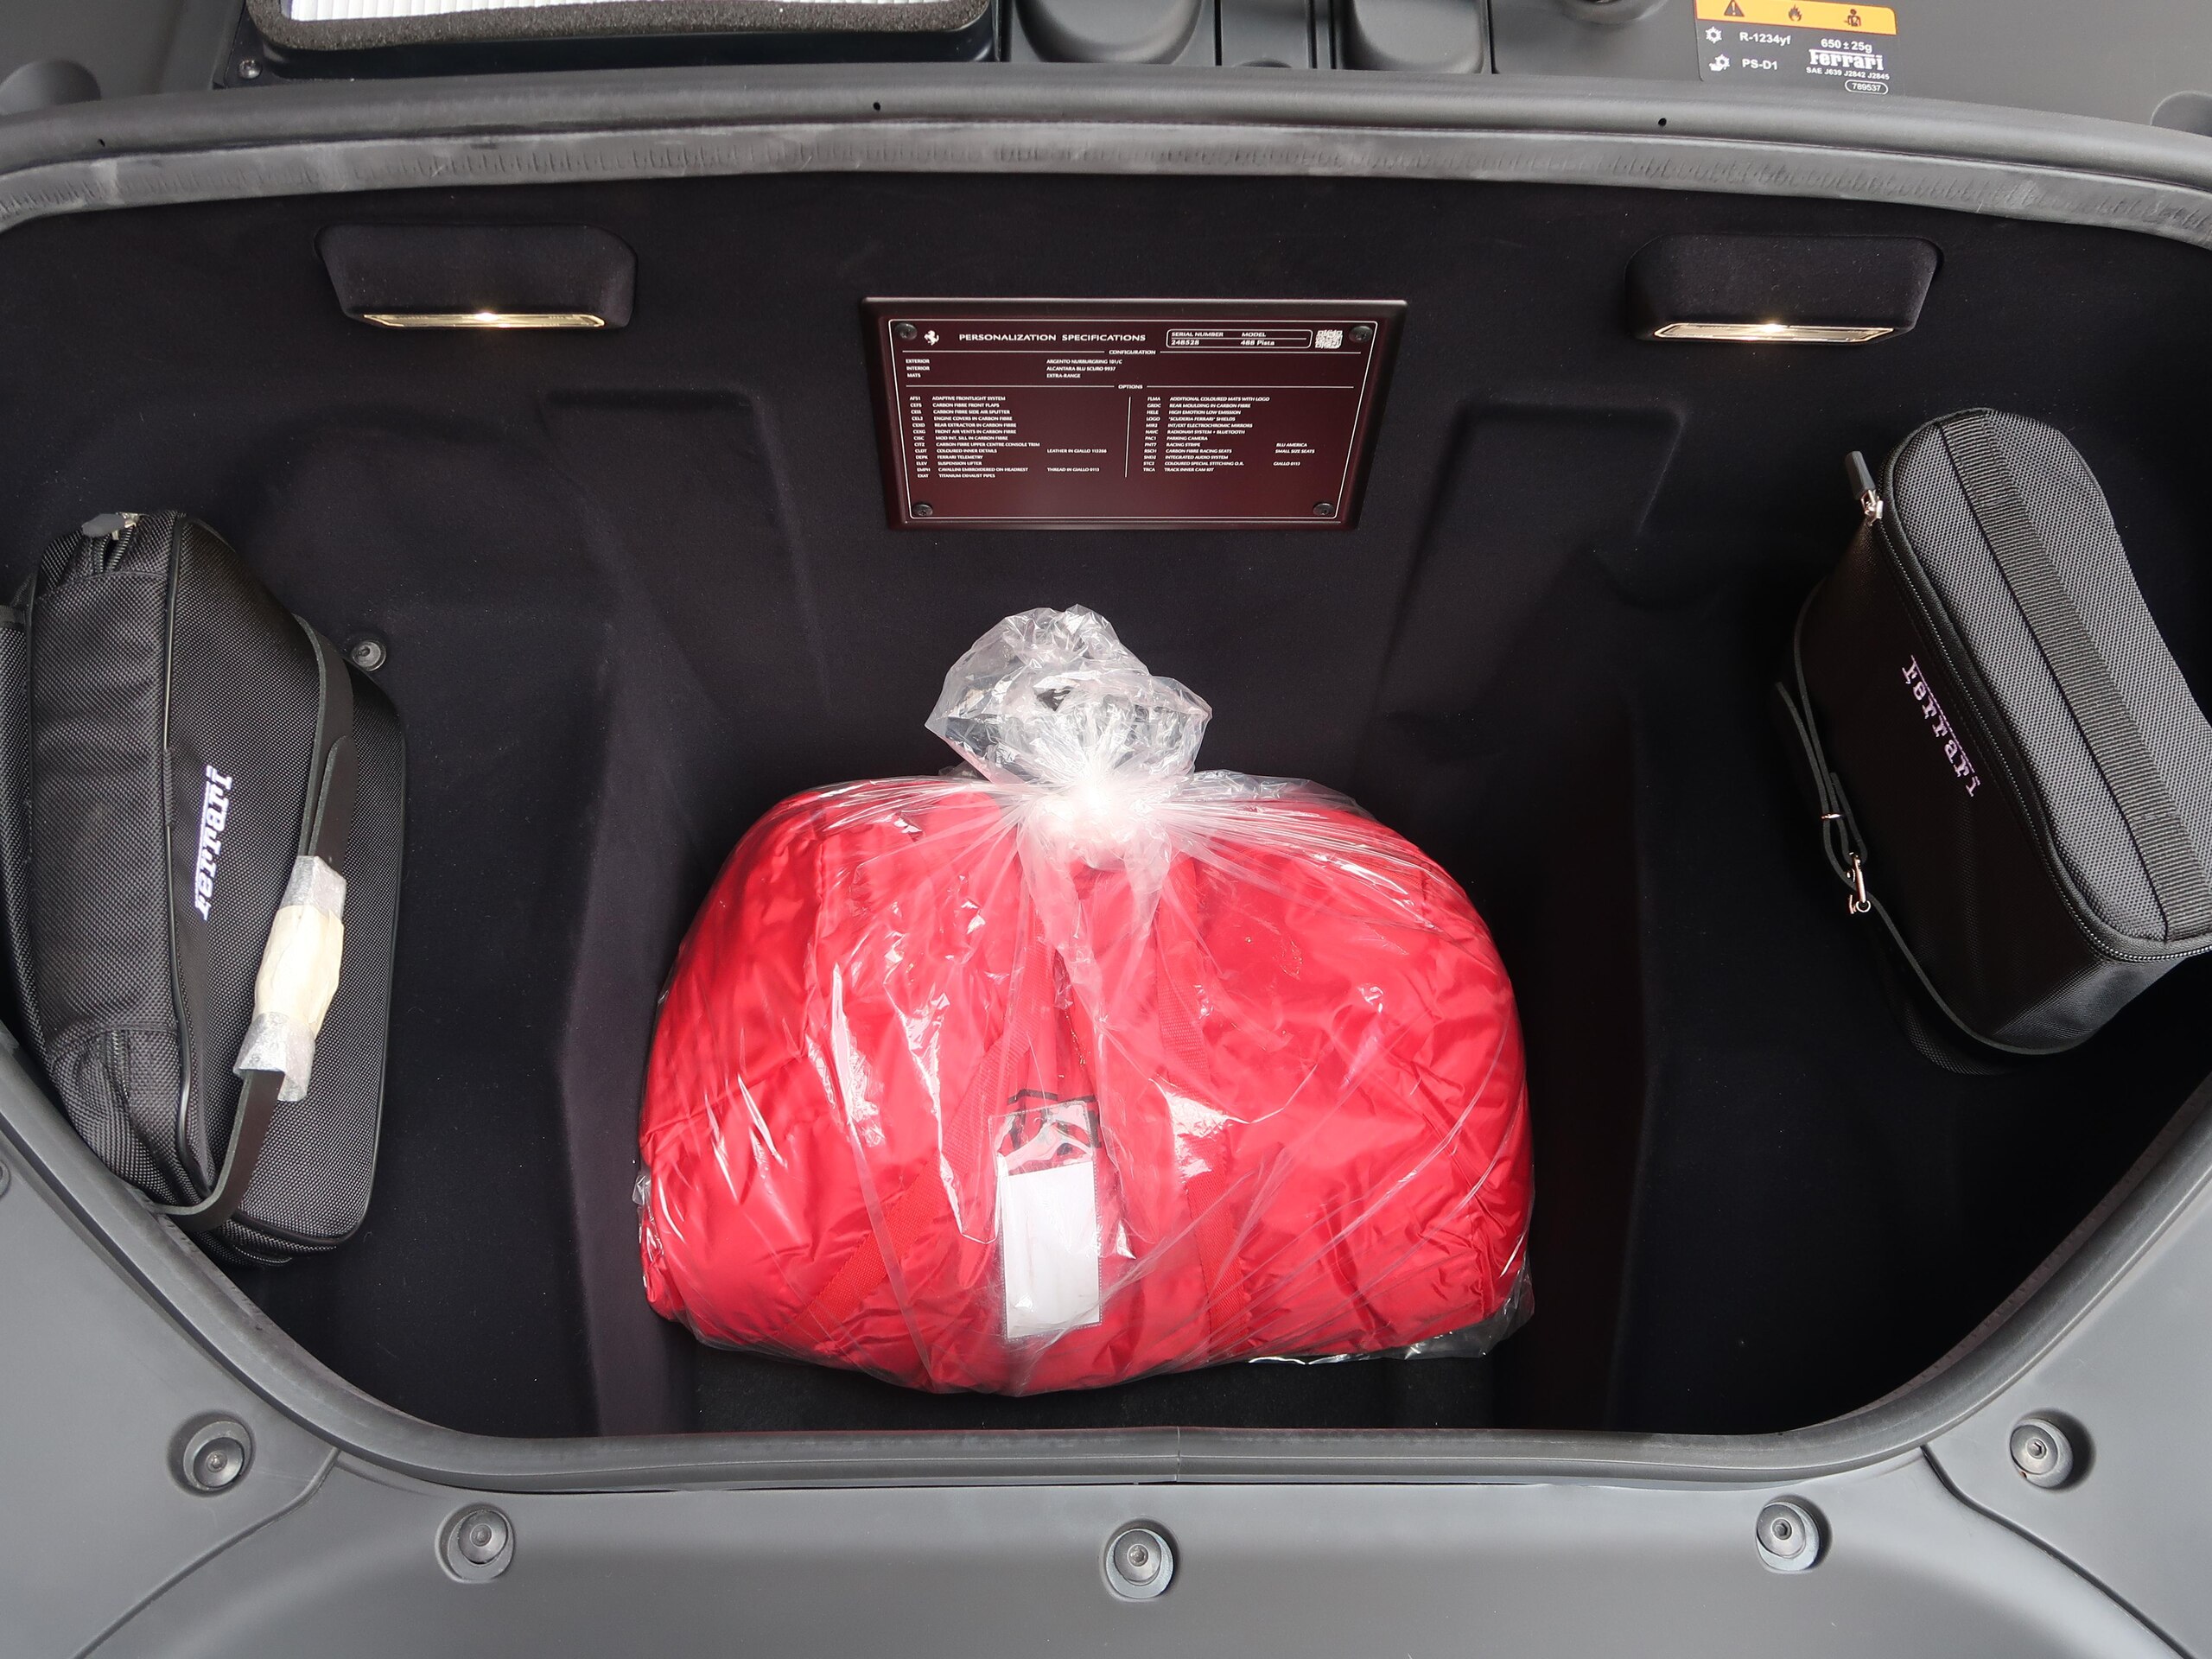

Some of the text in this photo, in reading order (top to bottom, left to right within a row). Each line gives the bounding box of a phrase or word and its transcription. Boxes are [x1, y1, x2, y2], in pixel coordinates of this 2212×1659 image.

[1738, 31, 1791, 47] R-1234yf
[1821, 38, 1841, 49] 650
[1851, 41, 1872, 54] 25g
[1741, 58, 1778, 71] PS-D1
[1808, 48, 1885, 71] Ferrari
[1844, 70, 1866, 79] J2842
[1852, 82, 1881, 92] 789537
[1902, 655, 1981, 798] Ferrari
[194, 764, 232, 922] Ferrari
